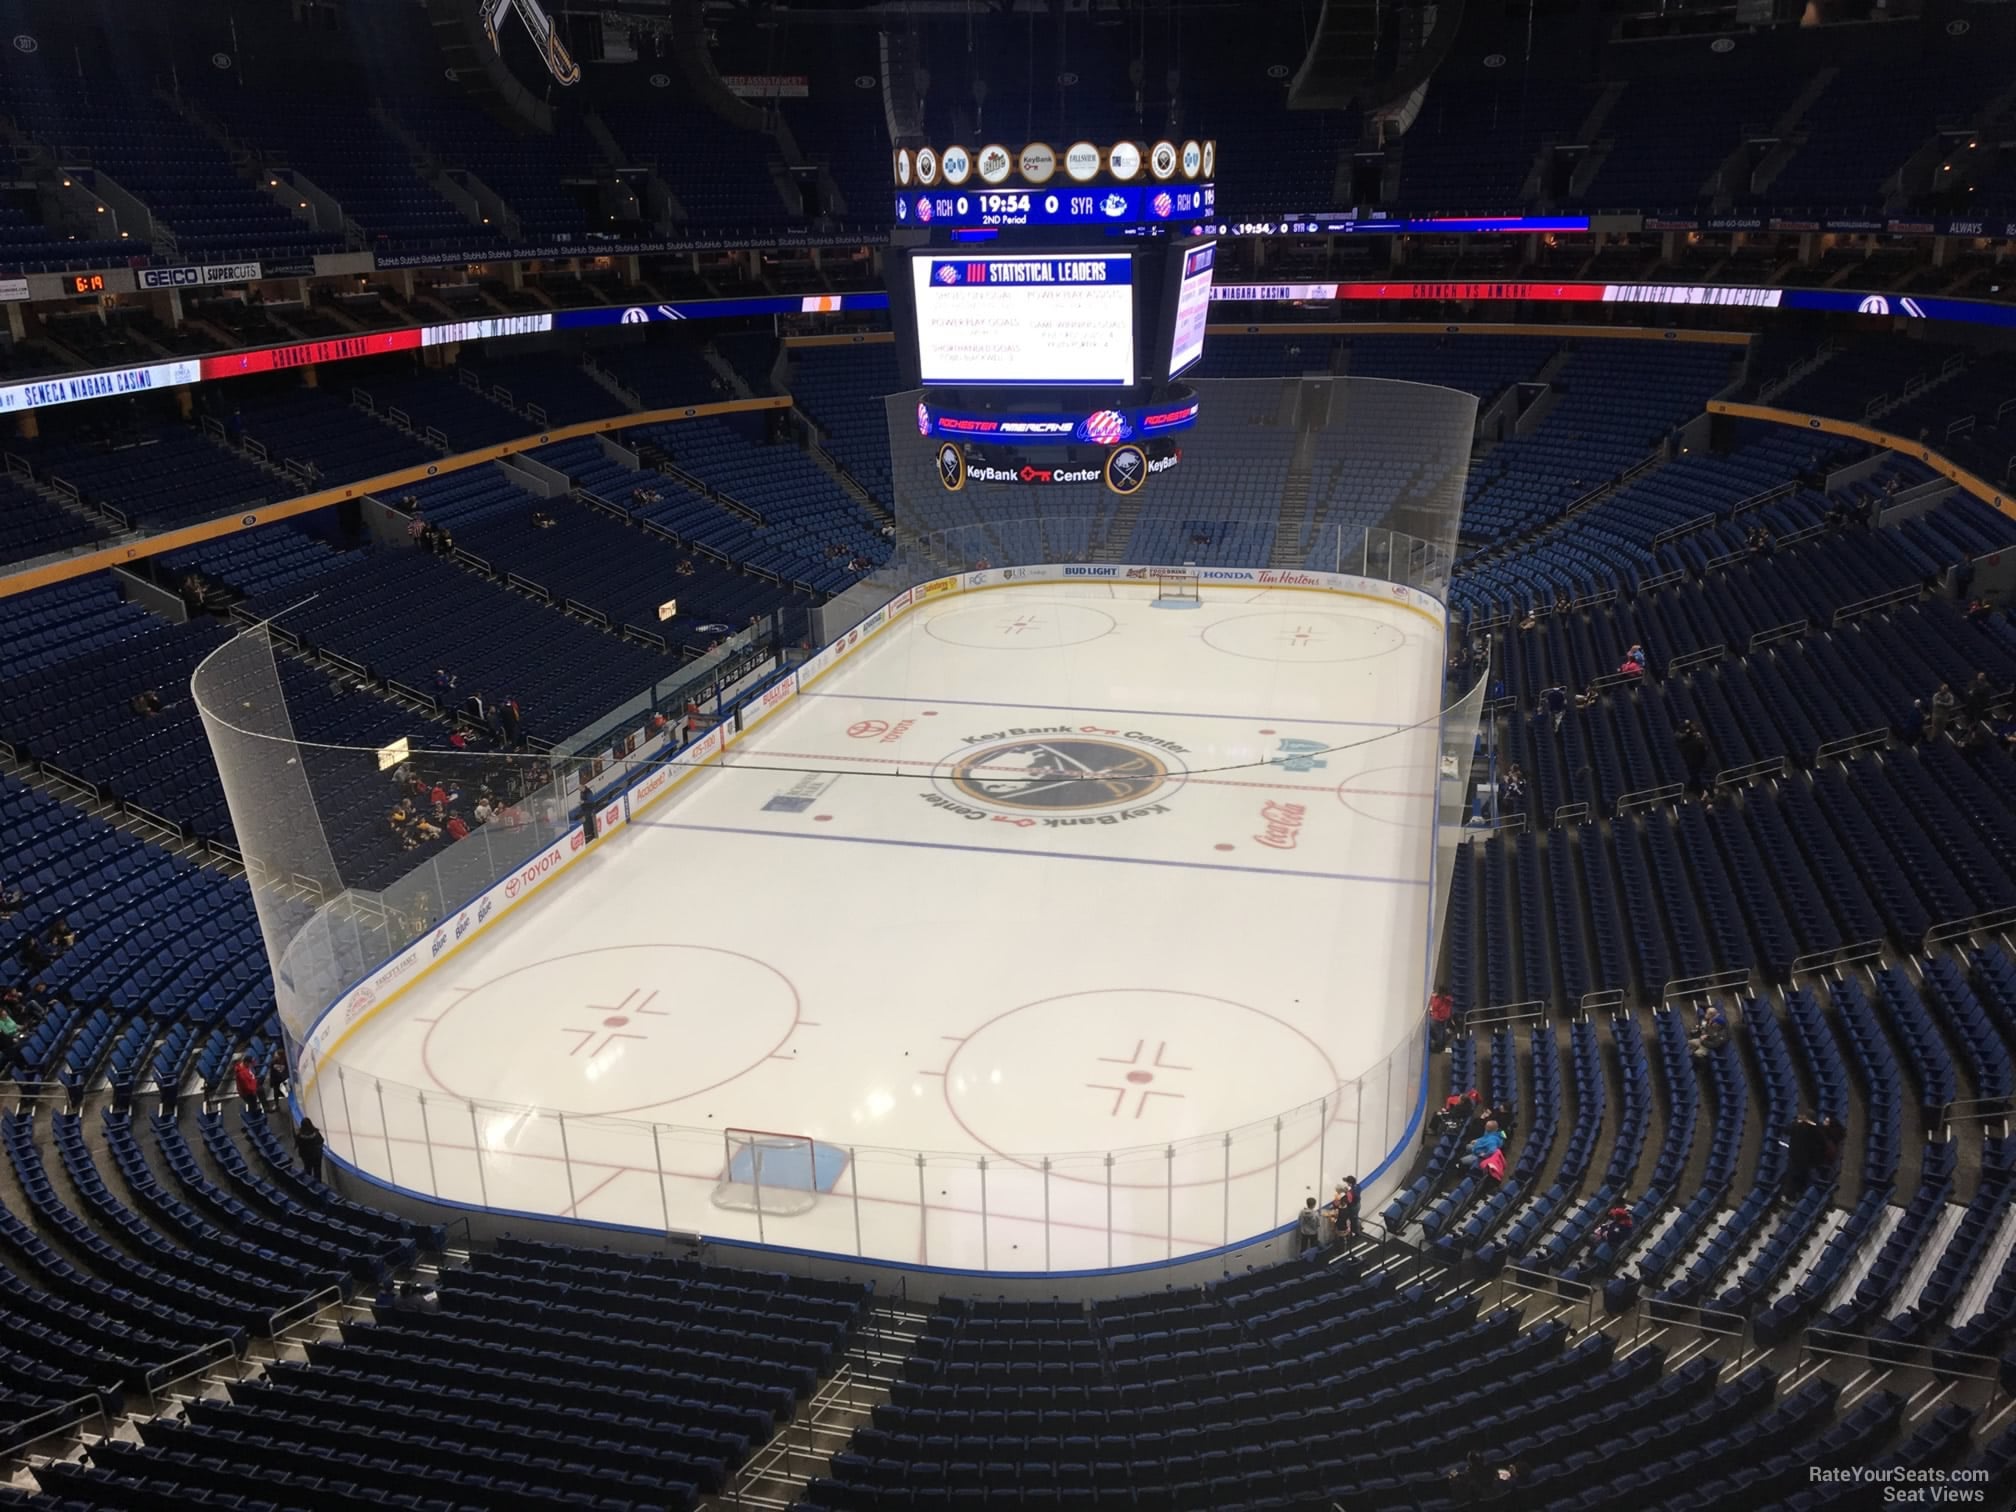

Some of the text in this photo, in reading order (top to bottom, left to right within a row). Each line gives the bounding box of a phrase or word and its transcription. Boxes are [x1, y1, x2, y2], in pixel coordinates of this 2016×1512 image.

[936, 198, 953, 217] RCH
[957, 196, 969, 215] 0
[979, 195, 1030, 212] 19:54
[1045, 195, 1059, 214] 0
[1071, 197, 1093, 215] SYR
[1177, 194, 1191, 211] RCH
[1193, 191, 1201, 208] 0
[982, 214, 1027, 225] 2ND Period
[1280, 223, 1288, 234] 0
[1949, 222, 1983, 234] ALWAYS
[1218, 224, 1227, 235] 0
[1239, 223, 1270, 235] 19:54
[145, 269, 198, 287] GEICO
[207, 265, 256, 281] SUPERCUTS
[990, 262, 1106, 282] STATISTICAL LEADERS
[76, 275, 104, 294] 6:19
[1222, 287, 1257, 299] NIAGARA
[1260, 287, 1290, 299] CASINO
[1413, 284, 1457, 298] CRUNCH
[1465, 284, 1479, 298] VS
[25, 382, 66, 406] SENECA
[71, 376, 114, 399] NIAGARA
[117, 369, 152, 393] CASINO
[939, 418, 1074, 432] ROCHESTER AMERICANS
[1148, 453, 1178, 473] KeyBank
[967, 465, 1101, 482] KeyBank Center
[1065, 567, 1087, 576] BUD
[1088, 567, 1117, 576] LIGHT
[1203, 570, 1254, 580] HONDA
[1258, 570, 1278, 583] Tim
[1279, 570, 1320, 586] Hortons
[880, 719, 917, 744] TOYOTA
[961, 725, 1192, 755] KeyBank Center
[919, 793, 1171, 828] KeyBank Center
[1254, 799, 1307, 850] Coca-Cola
[521, 849, 562, 886] TOYOTA
[478, 899, 493, 923] Blue
[455, 915, 472, 940] Blue
[432, 932, 448, 958] Blue
